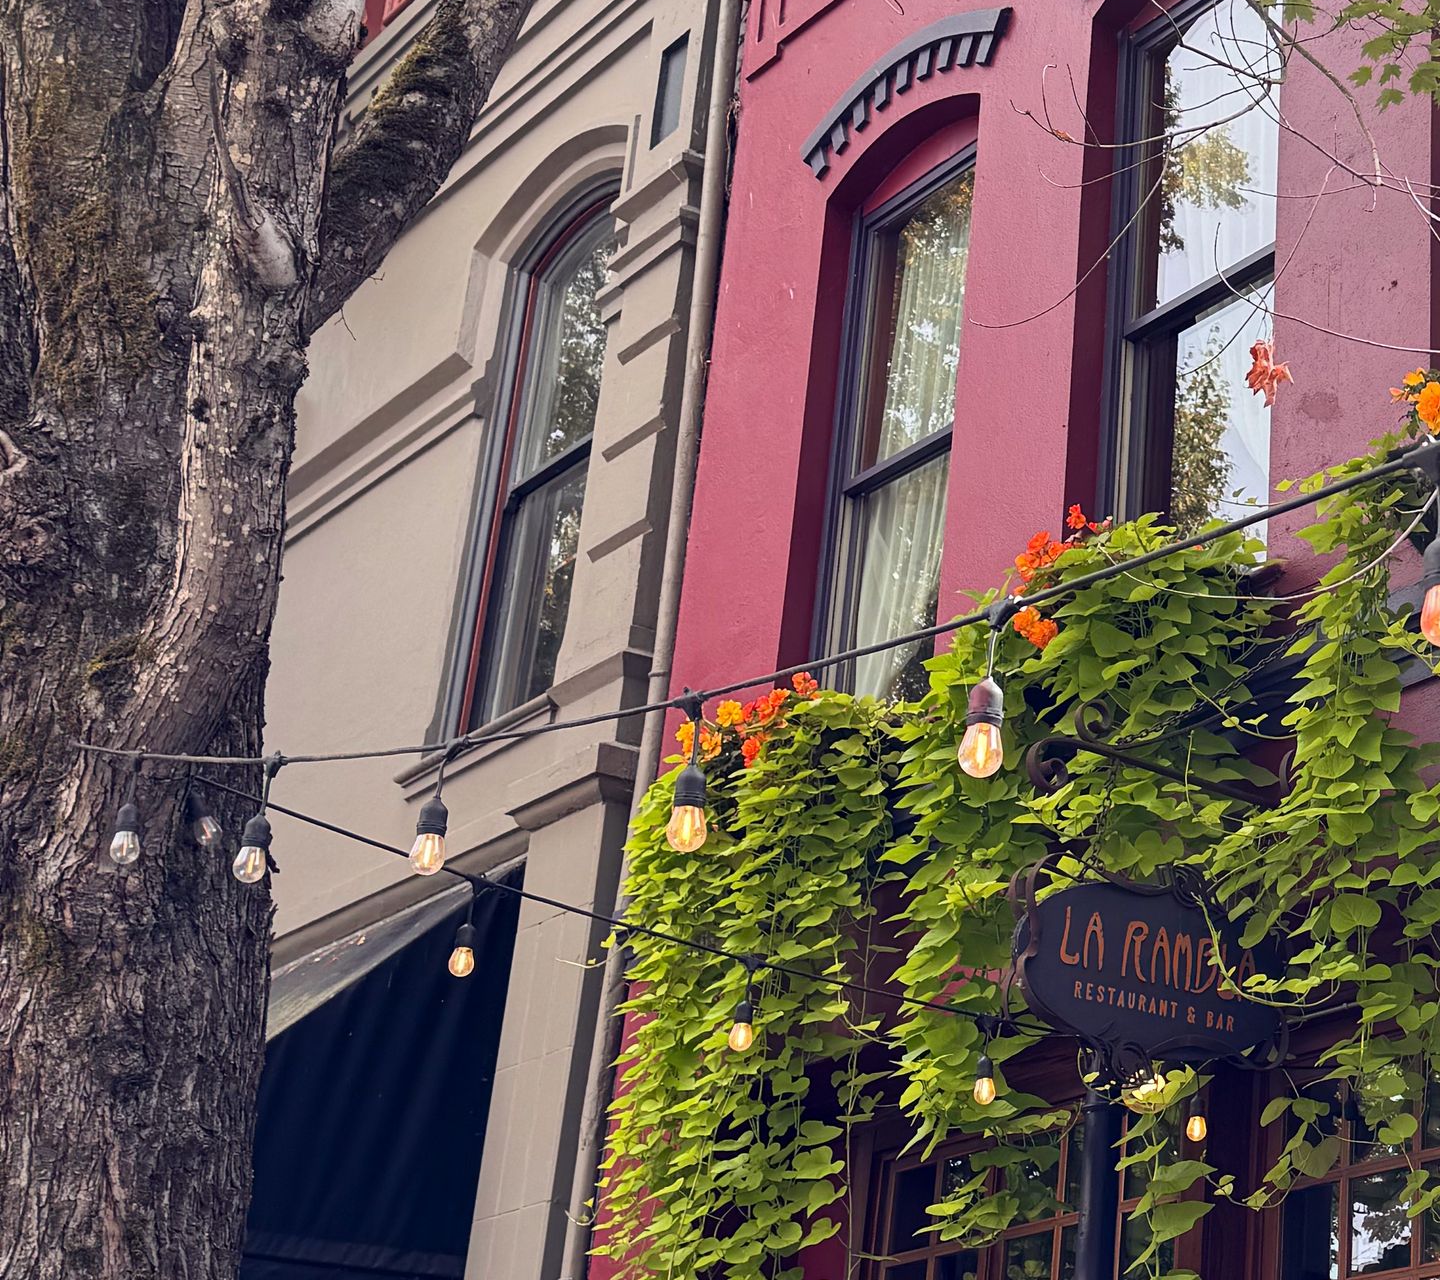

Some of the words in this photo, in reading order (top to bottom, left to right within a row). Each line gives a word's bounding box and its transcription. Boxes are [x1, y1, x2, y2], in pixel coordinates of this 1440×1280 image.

[1060, 905, 1105, 970] LA
[1121, 920, 1257, 1002] RAMBLA
[1074, 980, 1179, 1019] RESTAURANT
[1186, 1005, 1197, 1025] &
[1205, 1009, 1235, 1033] BAR
